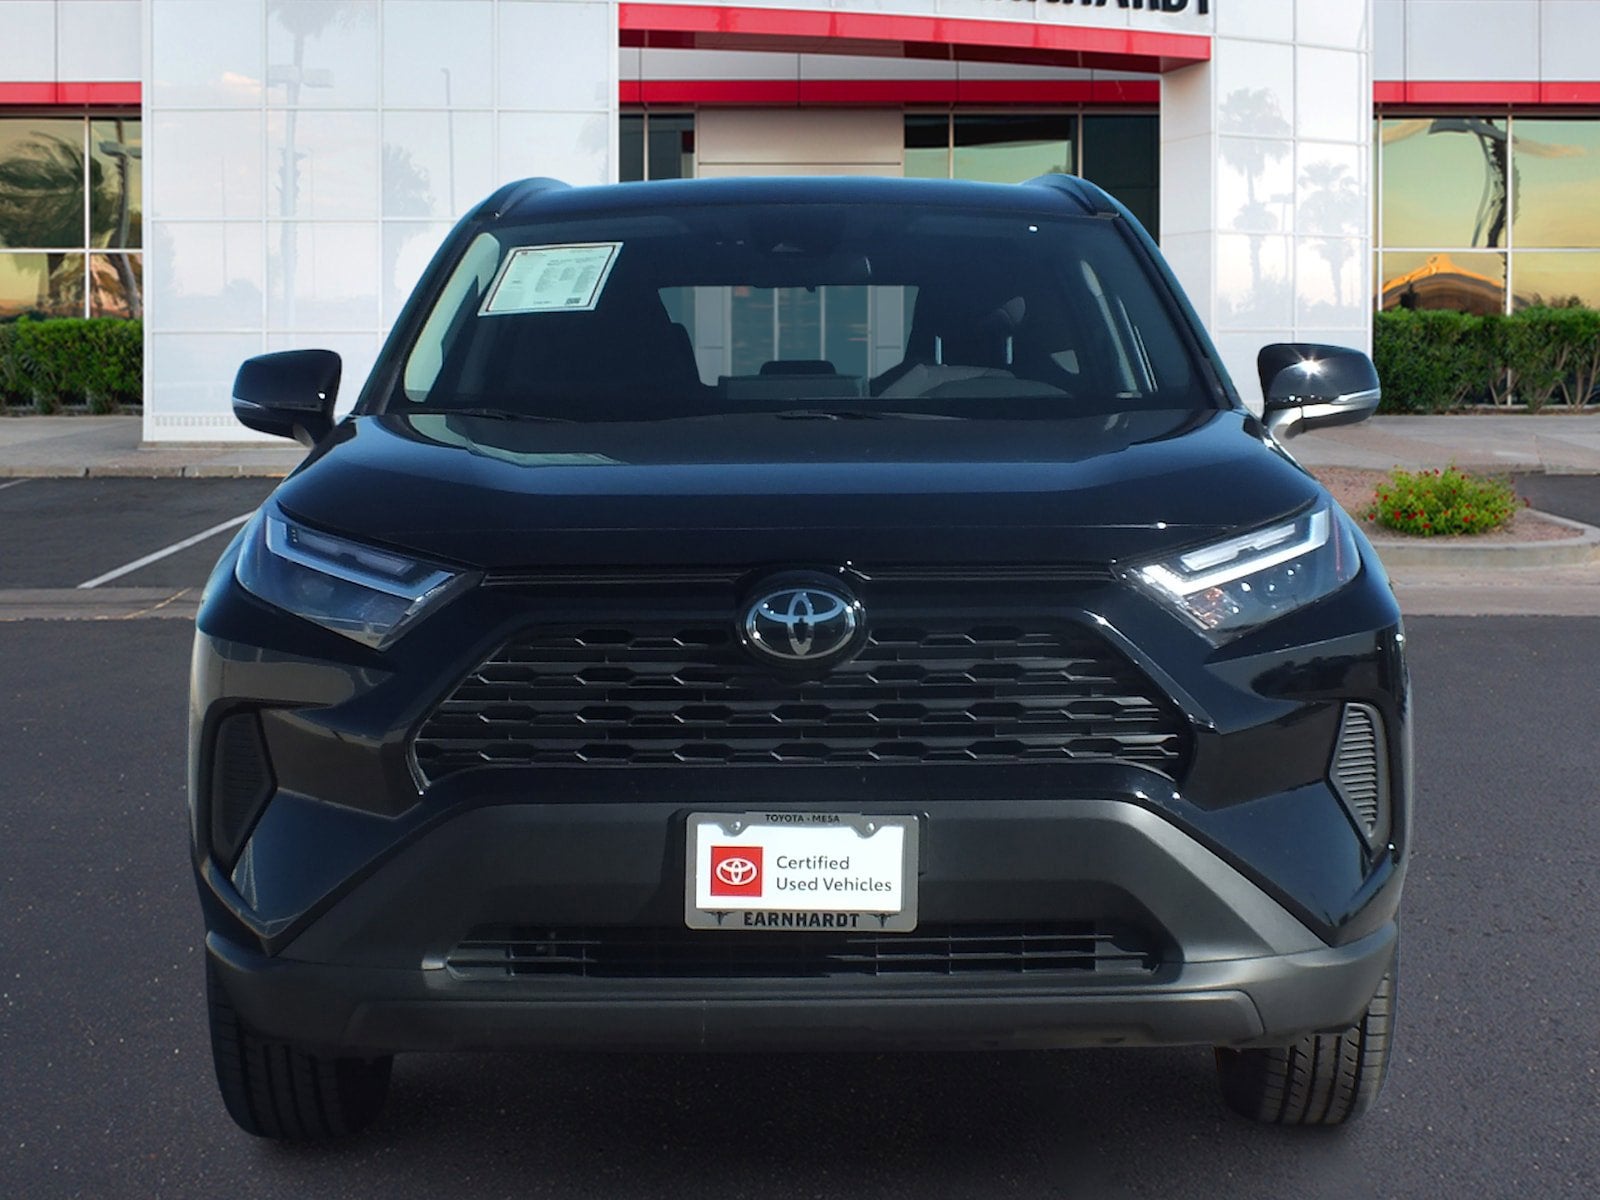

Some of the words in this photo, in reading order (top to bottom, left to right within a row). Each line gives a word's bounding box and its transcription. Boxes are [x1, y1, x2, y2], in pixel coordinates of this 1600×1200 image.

[765, 814, 804, 823] TOYOTA
[812, 814, 840, 823] MESA
[776, 855, 850, 870] Certified
[776, 877, 818, 891] Used
[823, 877, 892, 892] Vehicles
[743, 911, 860, 928] EARNHARDT
